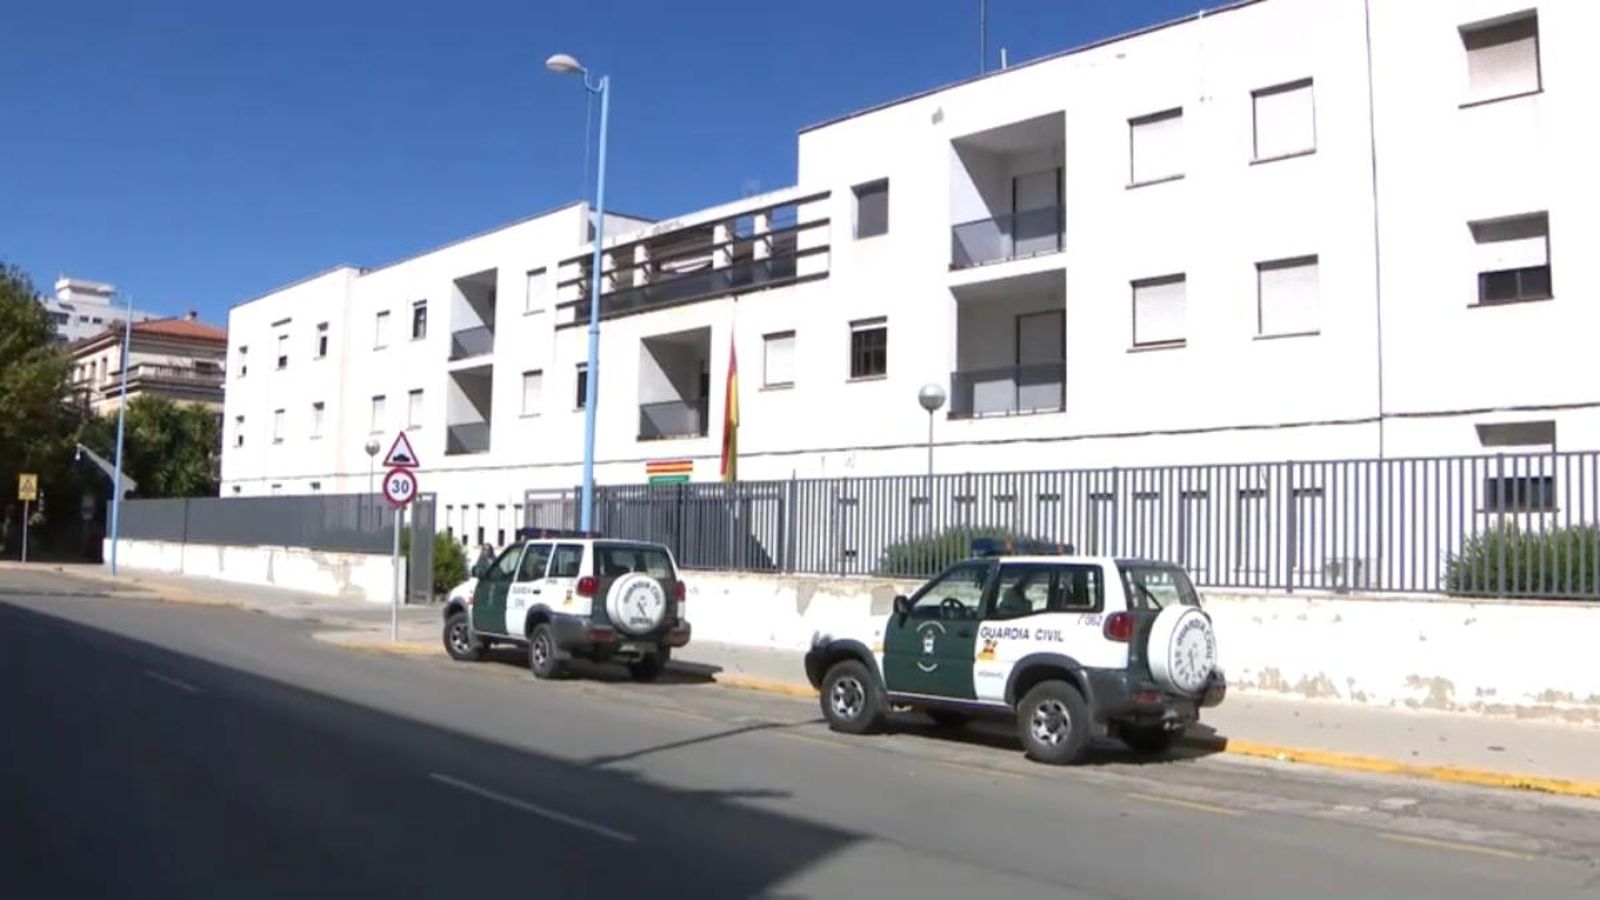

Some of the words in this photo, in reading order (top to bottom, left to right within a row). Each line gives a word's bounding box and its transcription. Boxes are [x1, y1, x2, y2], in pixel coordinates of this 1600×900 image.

[392, 479, 409, 494] 30
[980, 626, 1029, 640] GUARDIA
[1035, 628, 1064, 642] CIVIL
